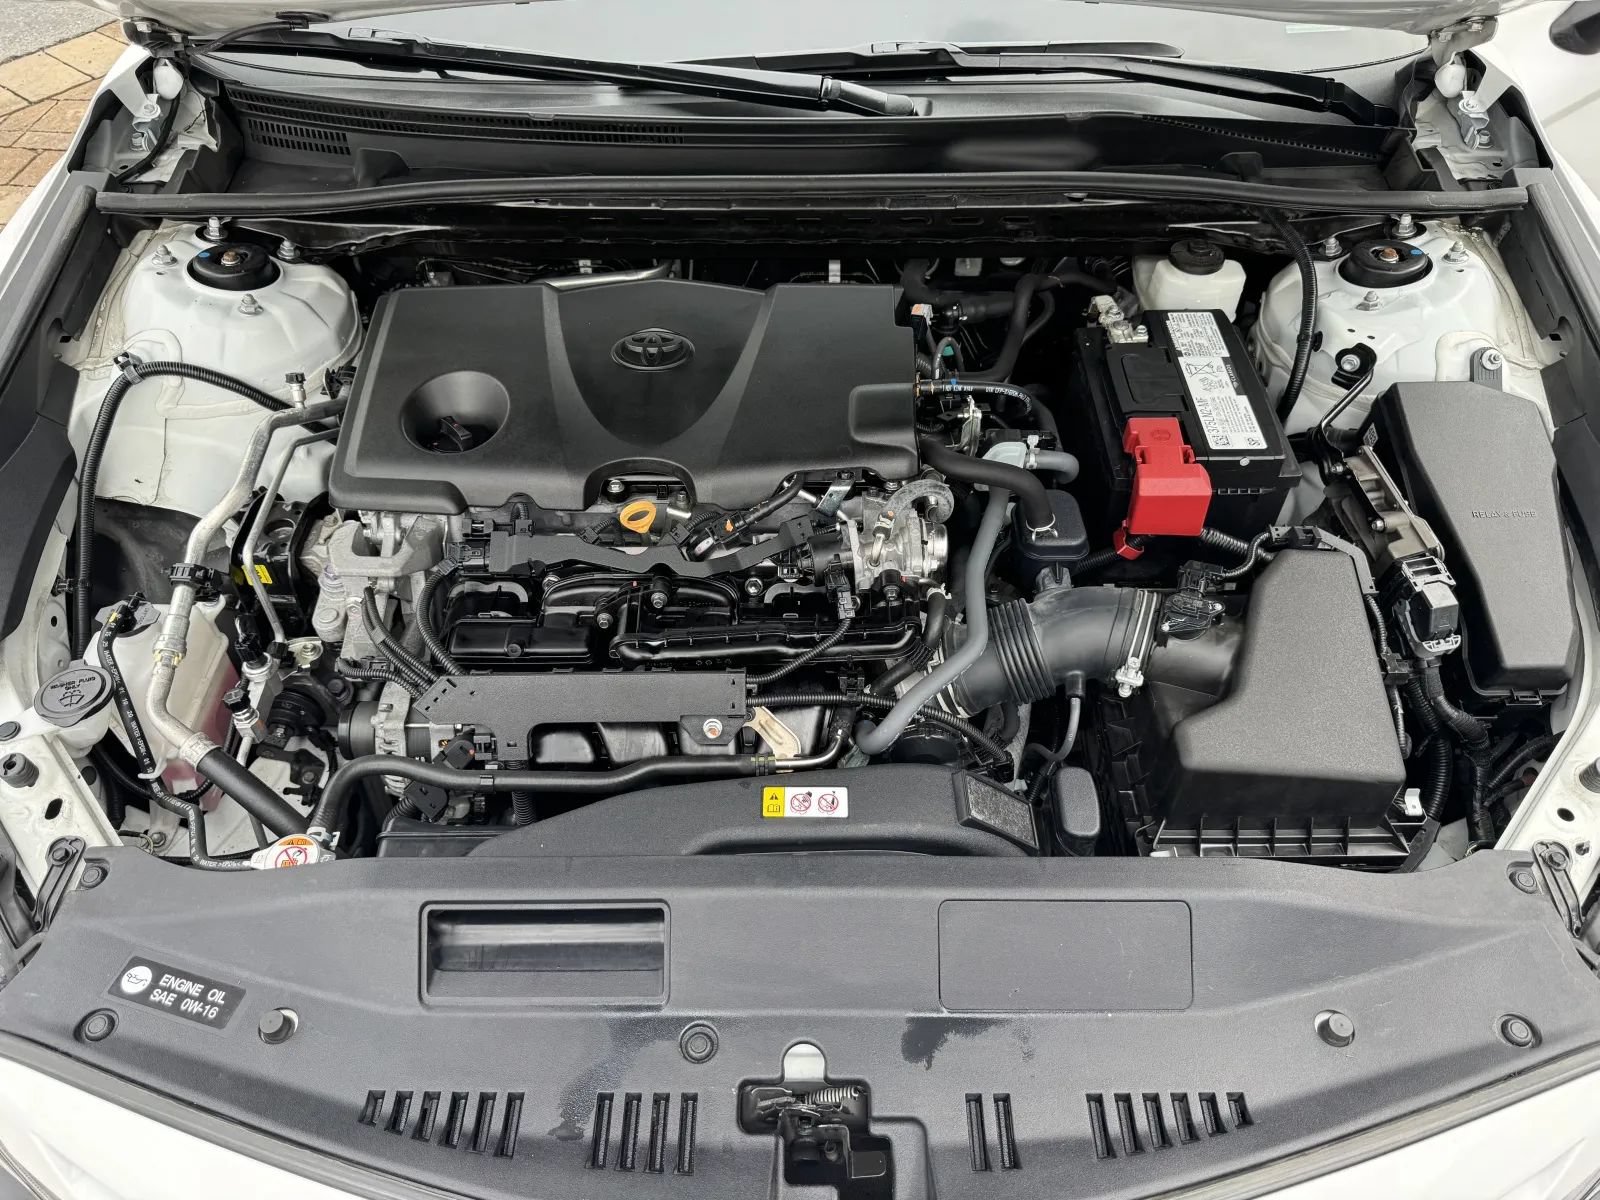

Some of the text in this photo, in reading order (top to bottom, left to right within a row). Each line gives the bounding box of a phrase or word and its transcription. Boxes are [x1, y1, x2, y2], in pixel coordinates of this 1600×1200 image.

[1471, 510, 1501, 519] RELAY
[1512, 510, 1537, 518] FUSE
[50, 676, 96, 689] WASHER FLUID
[64, 683, 81, 691] ONLY
[159, 973, 226, 1005] ENGINE OIL
[150, 988, 219, 1019] SAE 0W-16
